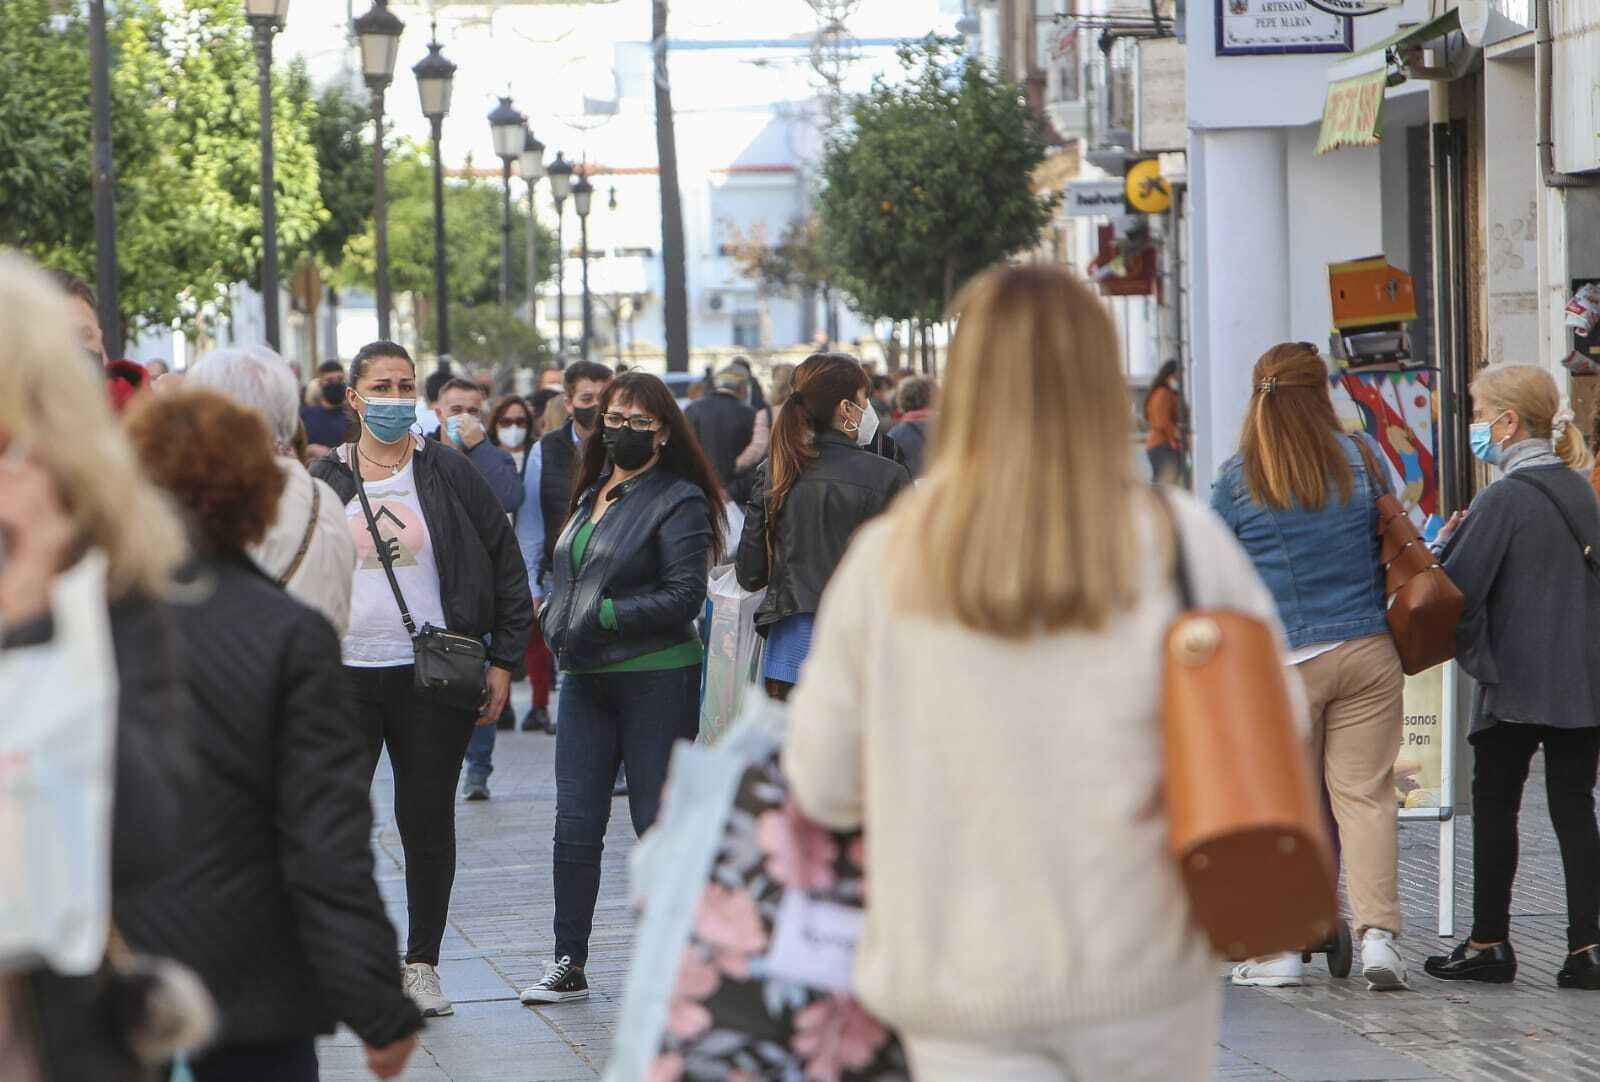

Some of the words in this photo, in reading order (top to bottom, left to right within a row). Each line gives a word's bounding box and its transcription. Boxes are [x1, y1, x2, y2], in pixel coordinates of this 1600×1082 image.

[1261, 1, 1308, 12] ARTESANO
[1255, 17, 1276, 28] PEPE
[1408, 732, 1431, 745] Pan
